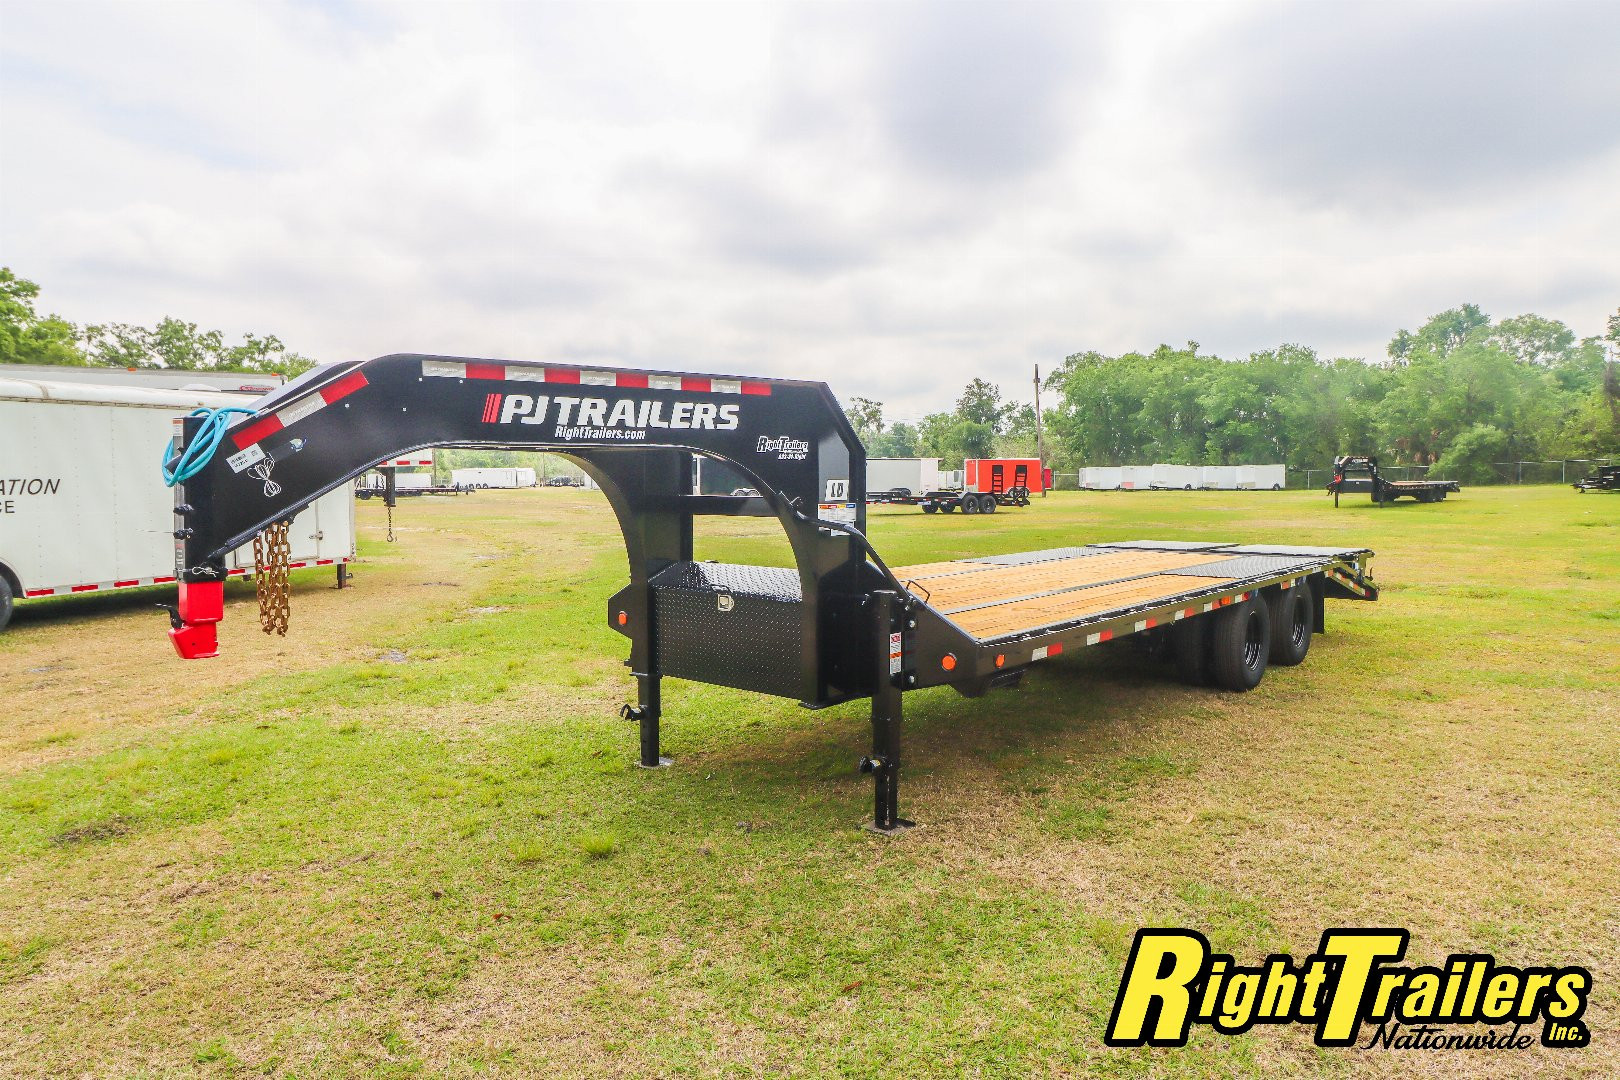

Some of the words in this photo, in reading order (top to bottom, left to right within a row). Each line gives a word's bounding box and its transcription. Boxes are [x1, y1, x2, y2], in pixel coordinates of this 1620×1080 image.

[500, 394, 549, 425] PJ
[553, 396, 739, 430] TRAILERS
[554, 425, 646, 441] RightTrailers.com
